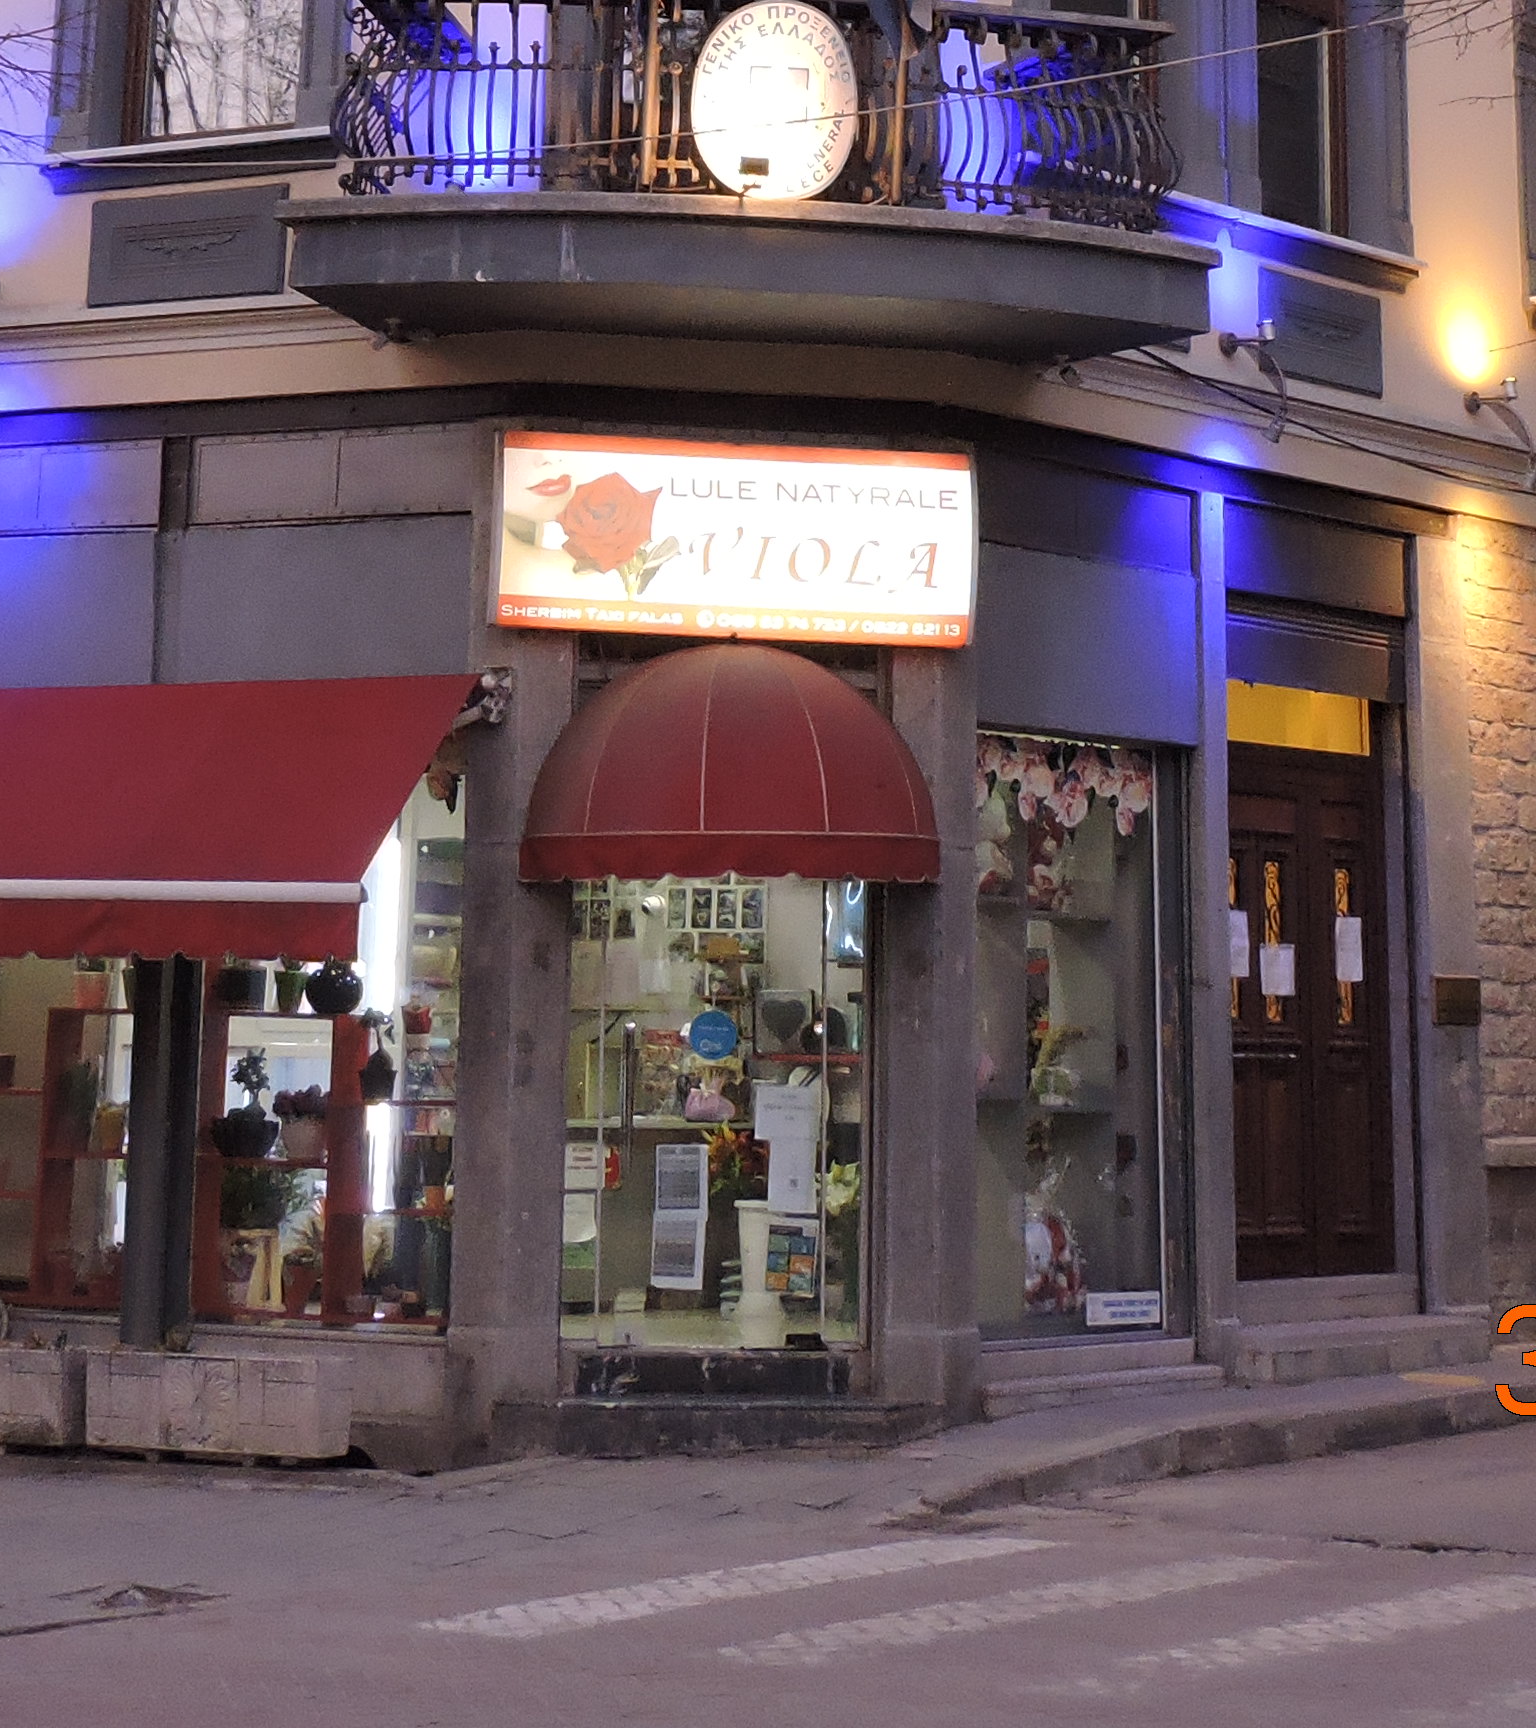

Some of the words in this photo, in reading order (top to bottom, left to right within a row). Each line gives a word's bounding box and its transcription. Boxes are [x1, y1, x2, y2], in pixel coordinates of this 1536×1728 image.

[702, 12, 754, 74] ΓΕΝΙΚΟ
[767, 6, 850, 83] ΠΡΟΞΕΝΕΙΟ
[718, 36, 746, 71] ΤΗΣ
[757, 22, 841, 82] ΕΛΛΑΔΟΣ
[669, 478, 757, 501] LULE
[776, 481, 959, 510] NATYRALE
